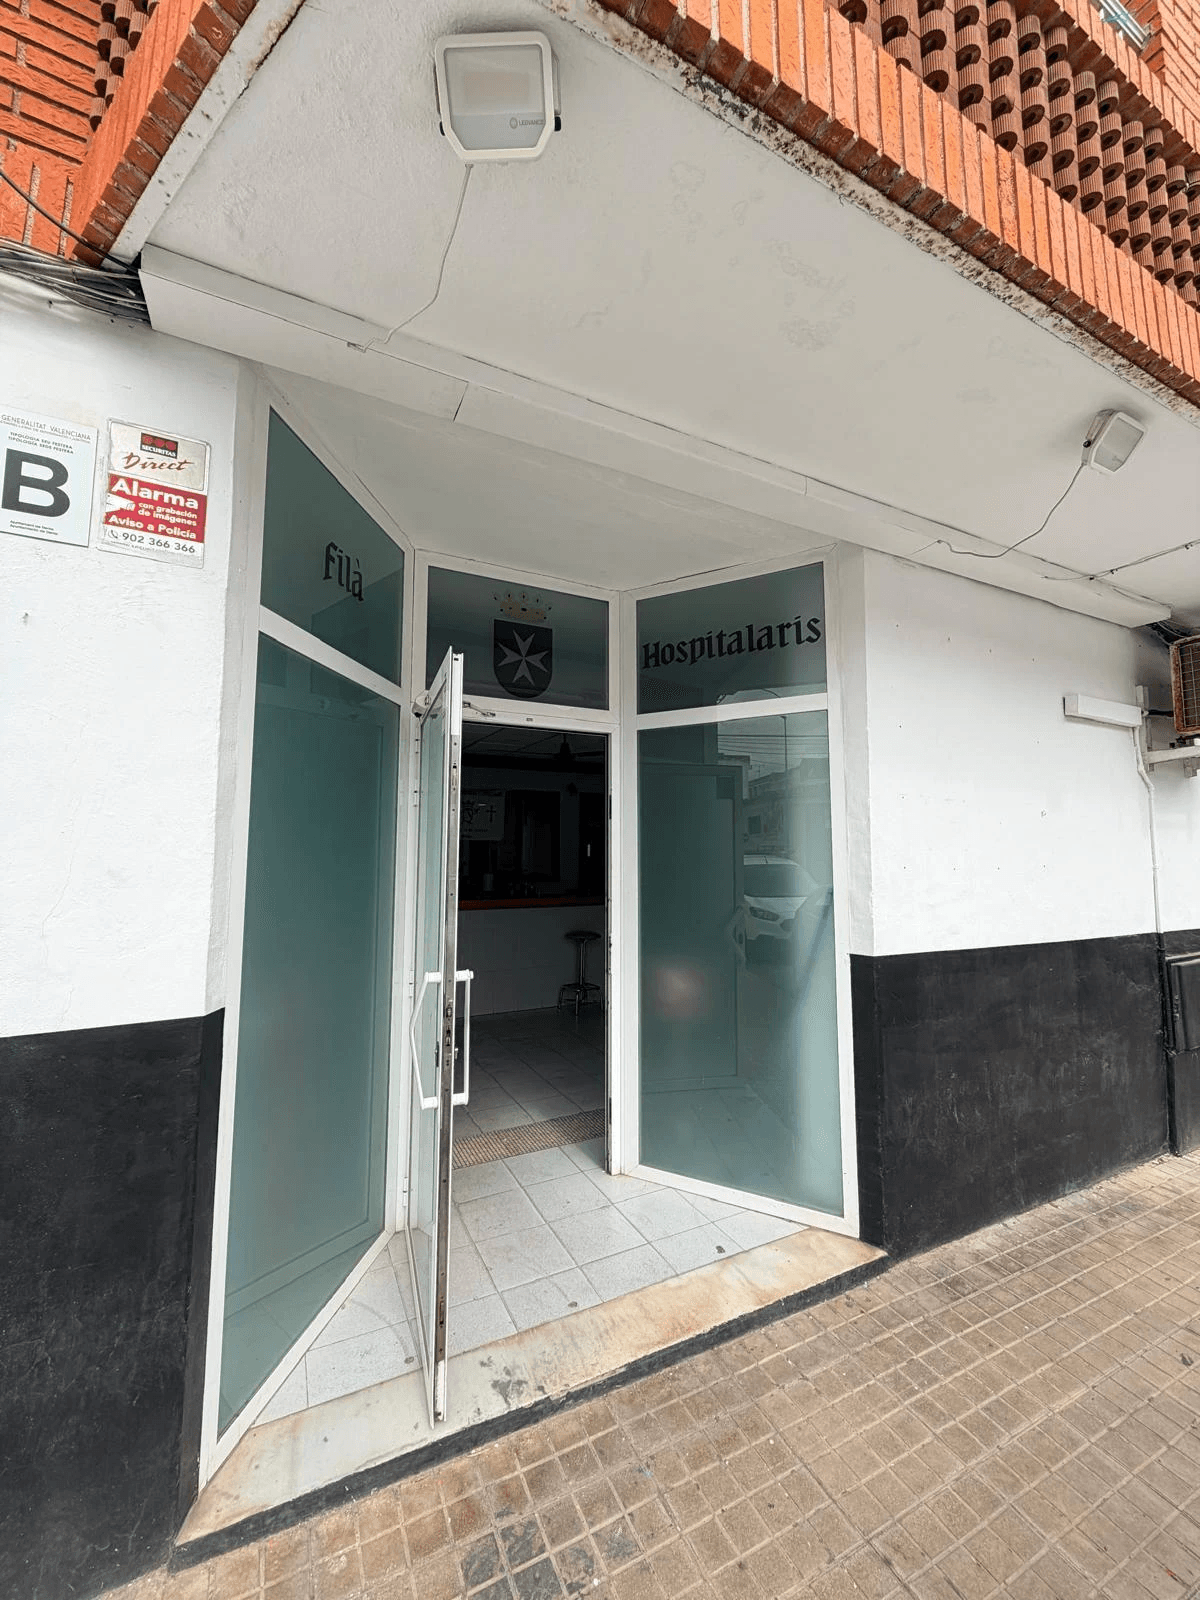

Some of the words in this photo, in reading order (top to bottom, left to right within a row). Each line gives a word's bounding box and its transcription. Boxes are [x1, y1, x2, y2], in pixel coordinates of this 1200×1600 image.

[1, 414, 46, 430] GENERALITAT
[50, 425, 91, 441] VALENCIANA
[122, 452, 194, 471] Direct
[141, 444, 177, 458] SECURITAS
[1, 448, 70, 517] B
[111, 477, 199, 510] Alarma
[138, 502, 154, 510] con
[156, 505, 198, 520] grabación
[138, 509, 151, 517] de
[152, 511, 198, 527] imágenes
[108, 515, 144, 529] Aviso
[147, 523, 155, 531] a
[158, 523, 197, 540] Policía
[122, 532, 145, 543] 902
[148, 537, 170, 549] 366
[174, 542, 196, 554] 366
[642, 615, 822, 669] Hospitalaris
